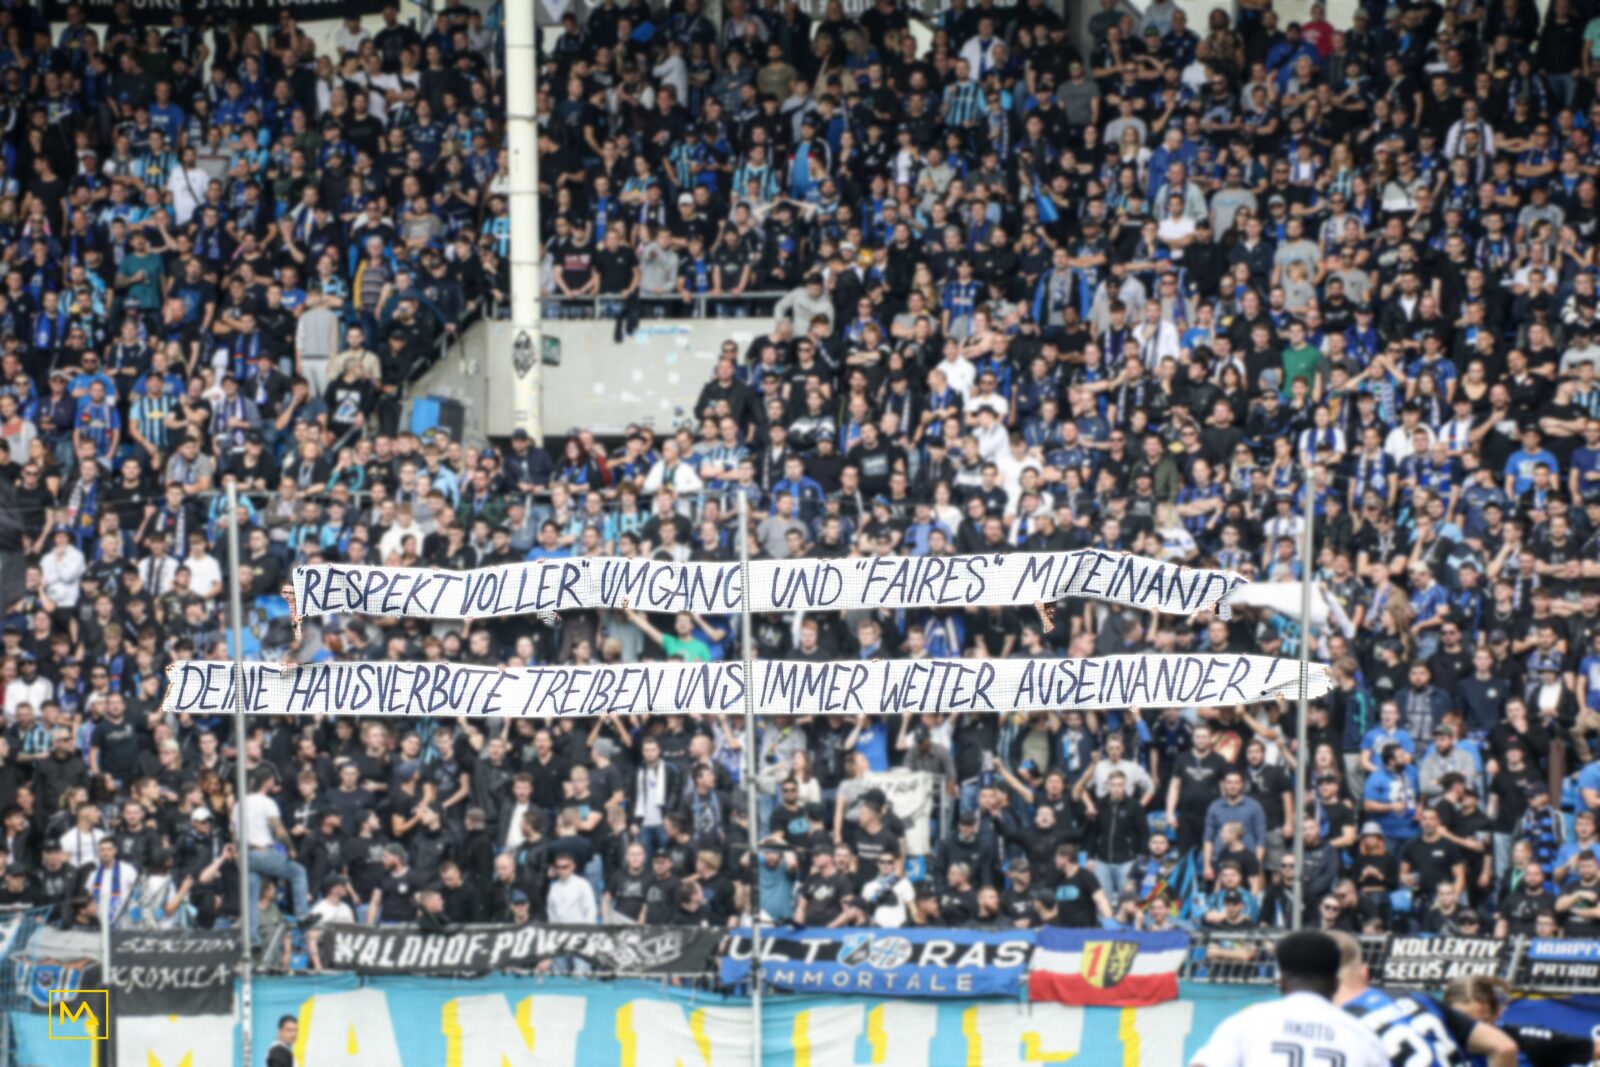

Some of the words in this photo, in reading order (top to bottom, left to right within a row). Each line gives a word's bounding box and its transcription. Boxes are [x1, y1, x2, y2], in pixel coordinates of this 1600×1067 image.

[600, 560, 743, 611] UMGANG
[771, 563, 843, 609] UND
[175, 664, 282, 712] DEINE
[286, 663, 520, 714] HAUSVERBOTE
[526, 666, 664, 715] TREIBEN
[675, 664, 745, 711] UNS
[761, 661, 869, 712] IMMER
[880, 661, 995, 712] WEITER
[1392, 937, 1504, 957] KOLLEKTIV
[757, 968, 974, 990] MMORTALE
